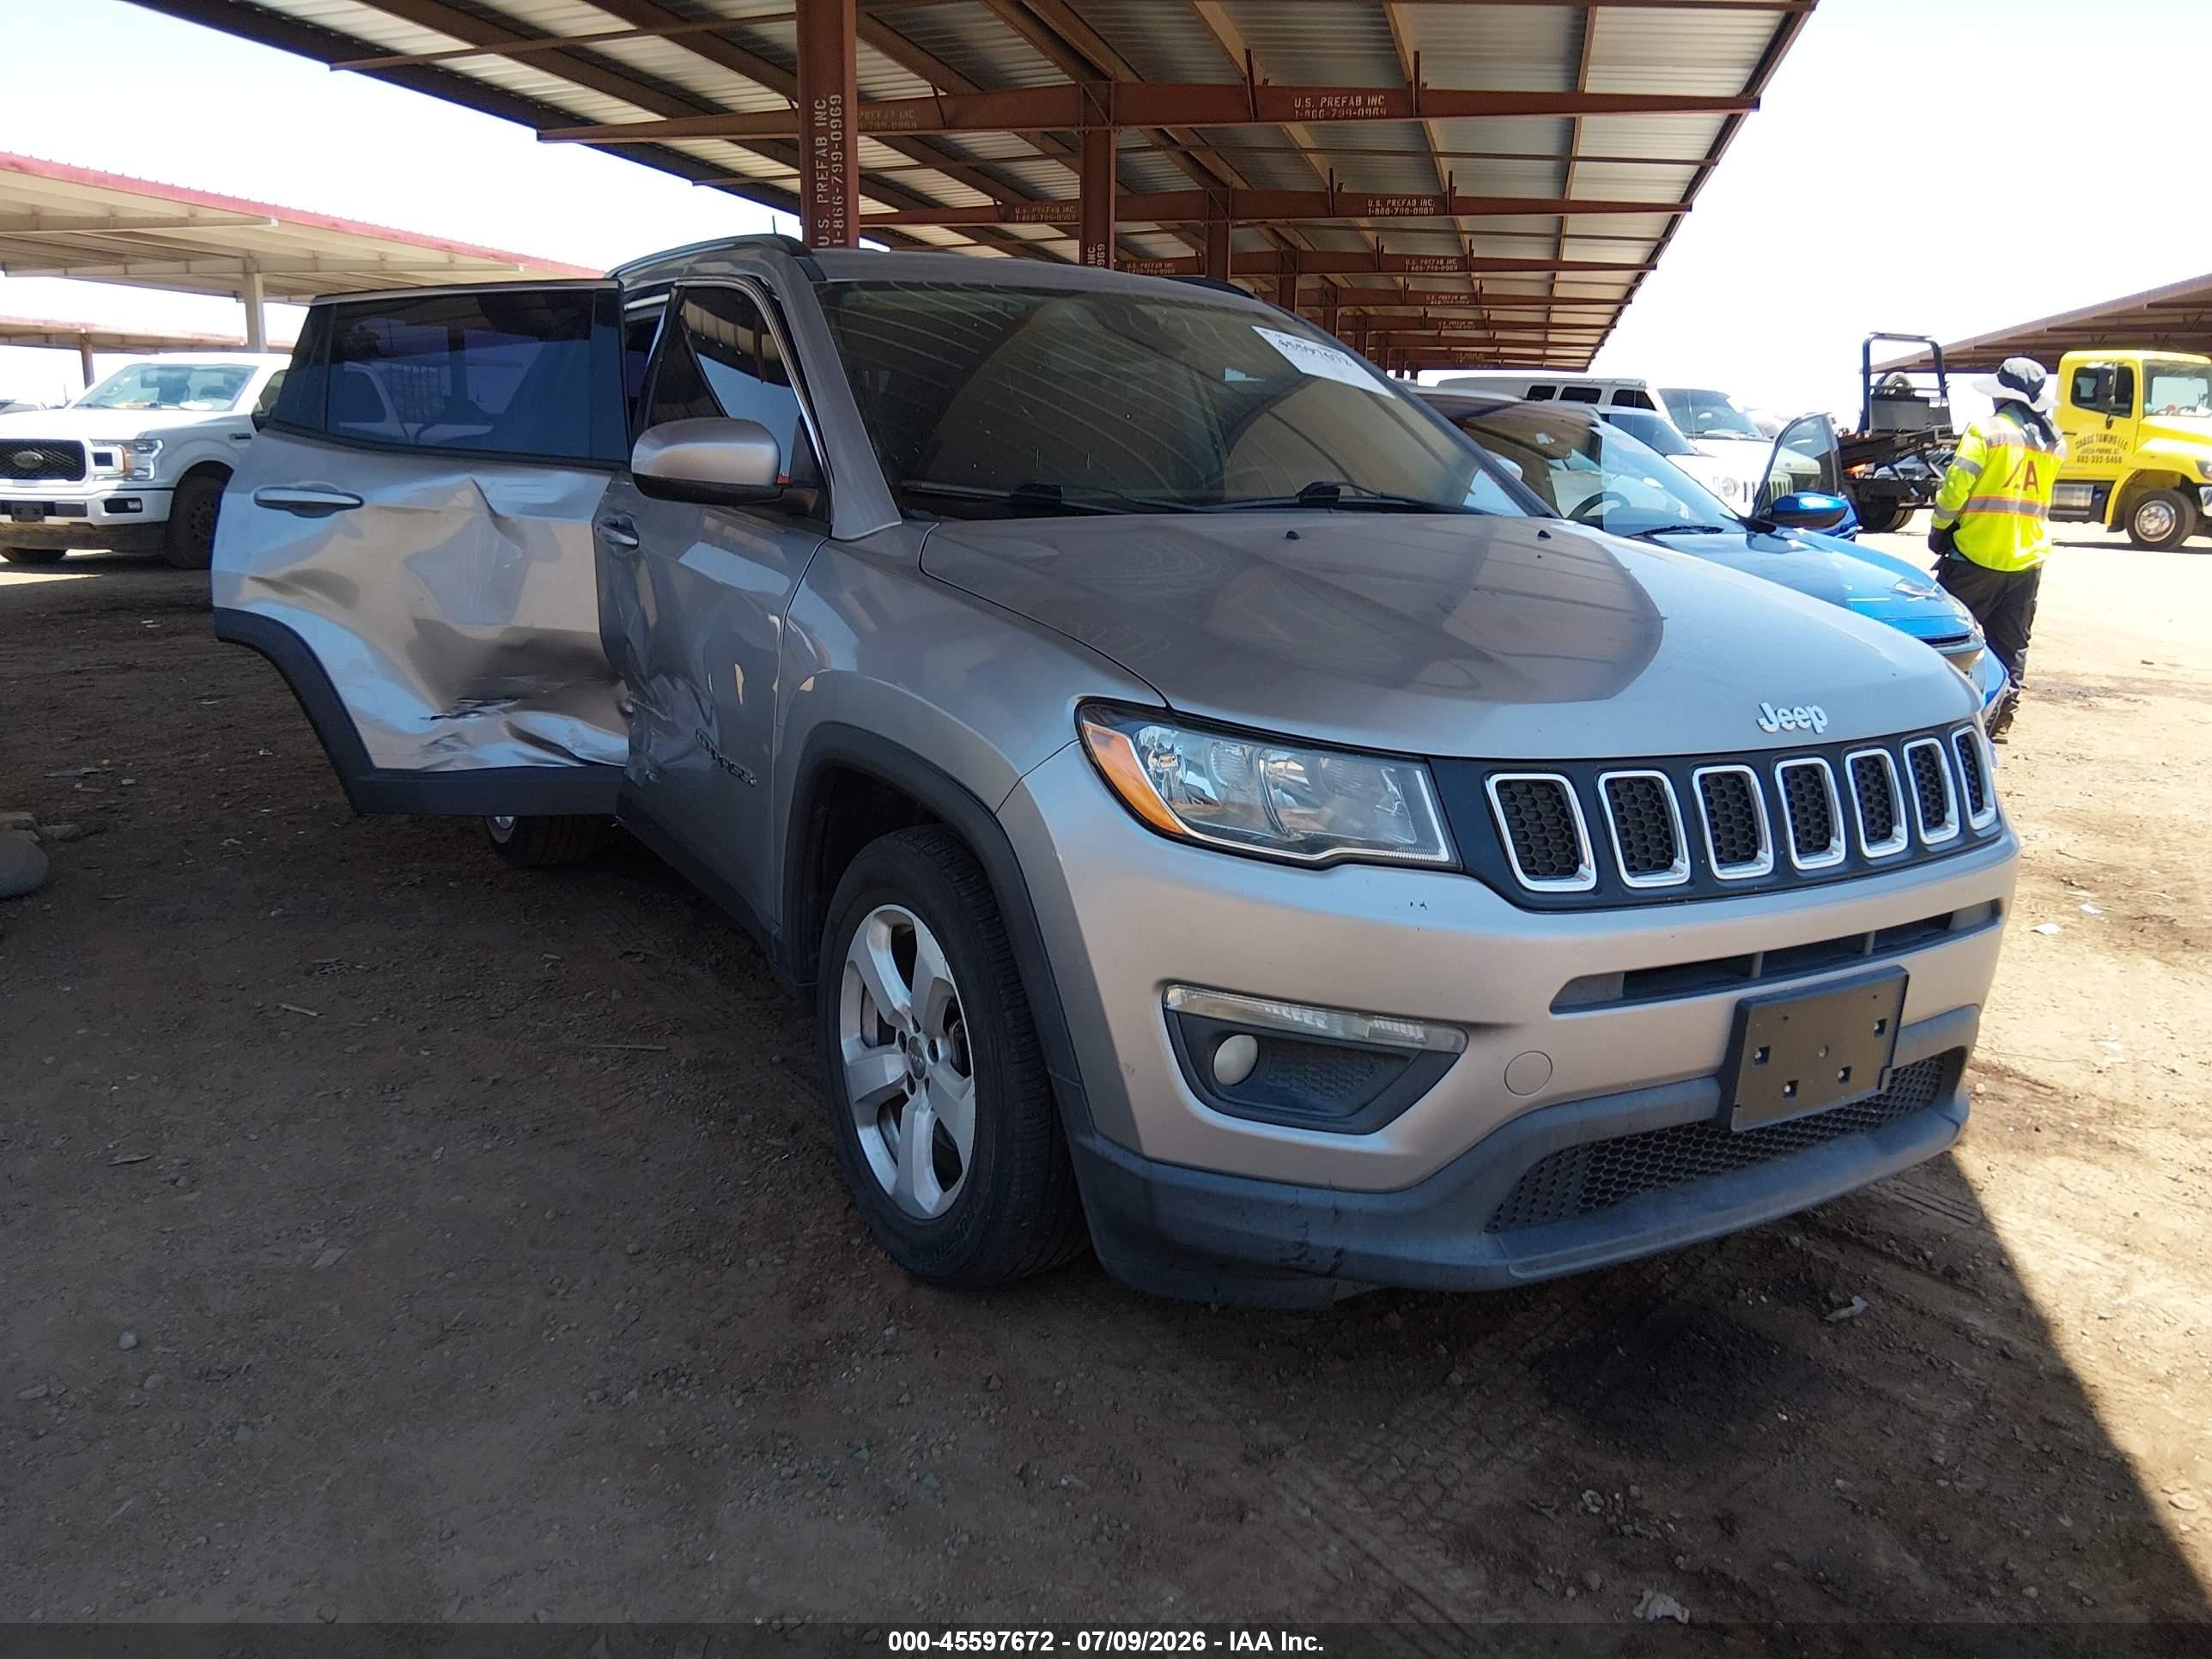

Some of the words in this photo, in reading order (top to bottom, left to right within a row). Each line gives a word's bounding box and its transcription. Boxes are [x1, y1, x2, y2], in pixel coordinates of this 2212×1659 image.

[1321, 95, 1362, 108] PREFAB
[816, 137, 830, 204] PREFAB
[830, 94, 846, 245] 1-866-799-0969
[817, 214, 830, 247] U.S.
[1756, 702, 1828, 735] Jeep
